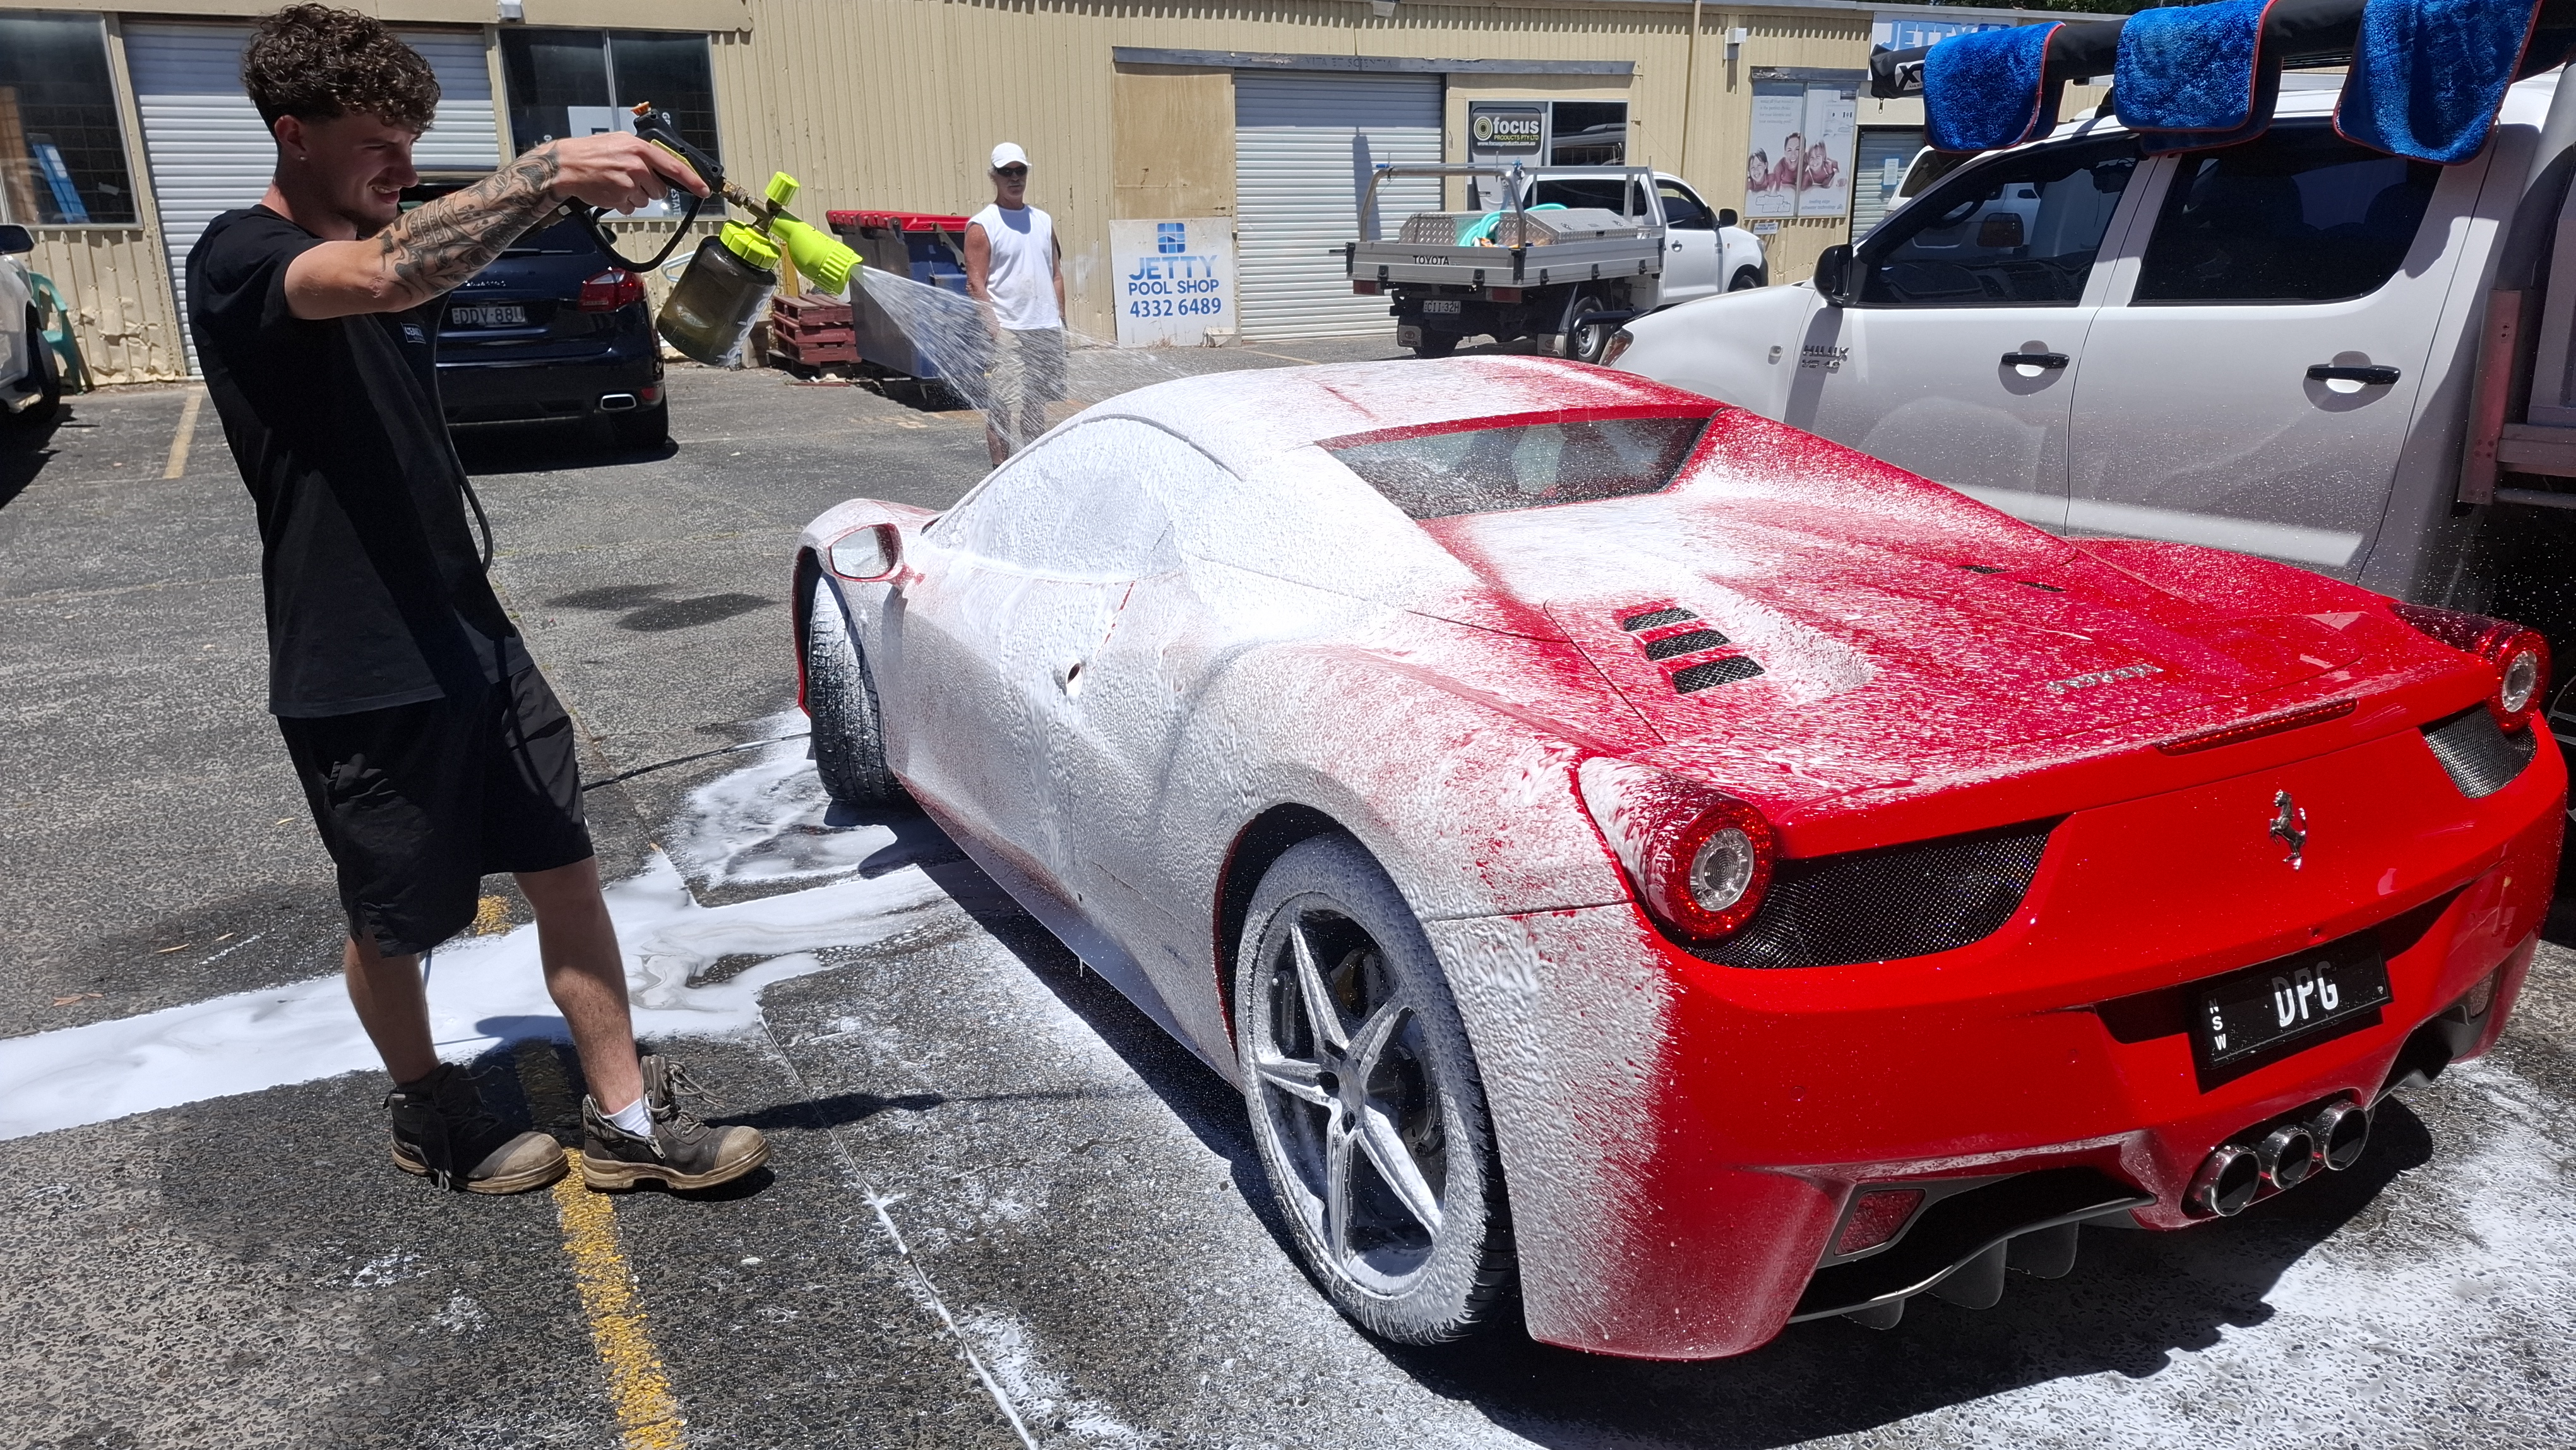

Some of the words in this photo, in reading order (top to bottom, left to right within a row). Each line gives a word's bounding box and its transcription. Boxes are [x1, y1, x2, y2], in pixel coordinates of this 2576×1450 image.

[1493, 117, 1539, 134] focus
[1128, 255, 1217, 280] JETTY
[1413, 255, 1450, 265] TOYOTA
[1128, 281, 1172, 296] POOL
[1177, 279, 1219, 294] SHOP
[1130, 299, 1174, 318] 4332
[1178, 297, 1222, 316] 6489
[2272, 961, 2338, 1027] DPG
